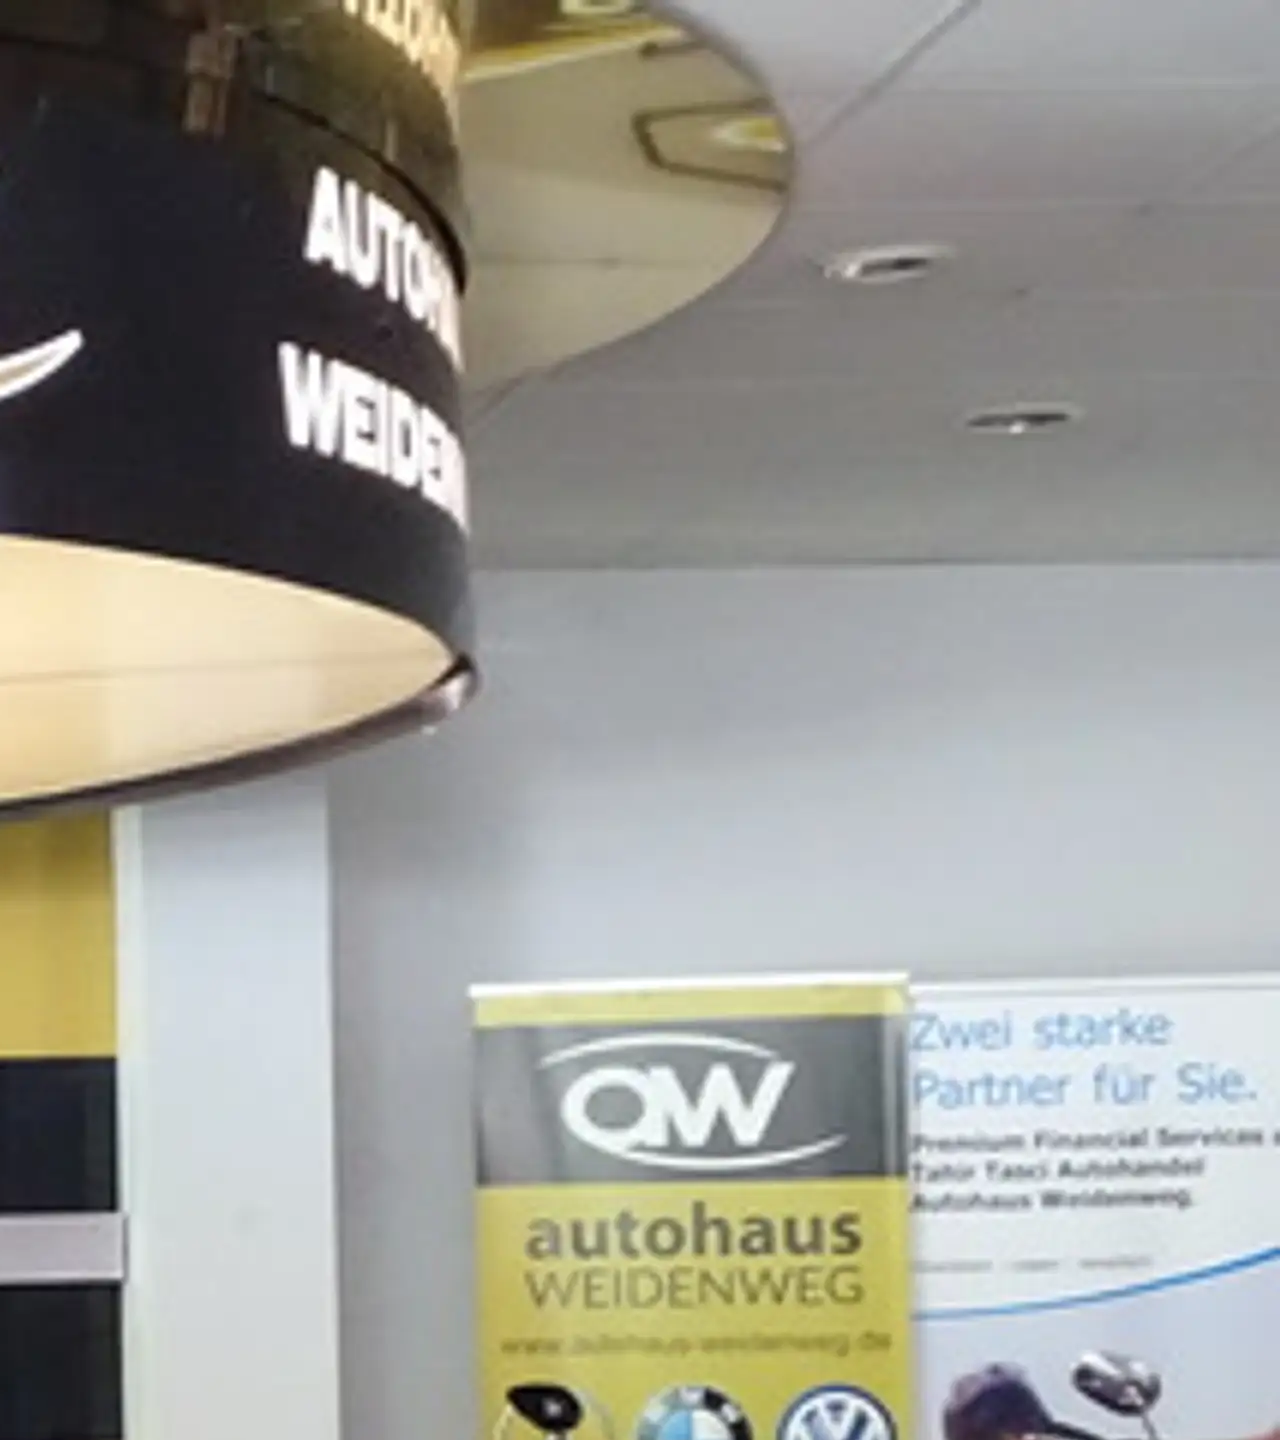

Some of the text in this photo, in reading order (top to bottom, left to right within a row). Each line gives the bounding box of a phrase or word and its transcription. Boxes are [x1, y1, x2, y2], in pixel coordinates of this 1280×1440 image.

[911, 1007, 1174, 1049] Zwei starke
[912, 1061, 1257, 1108] Partner für Sie.
[525, 1201, 862, 1262] autohaus
[524, 1265, 865, 1309] WEIDENWEG
